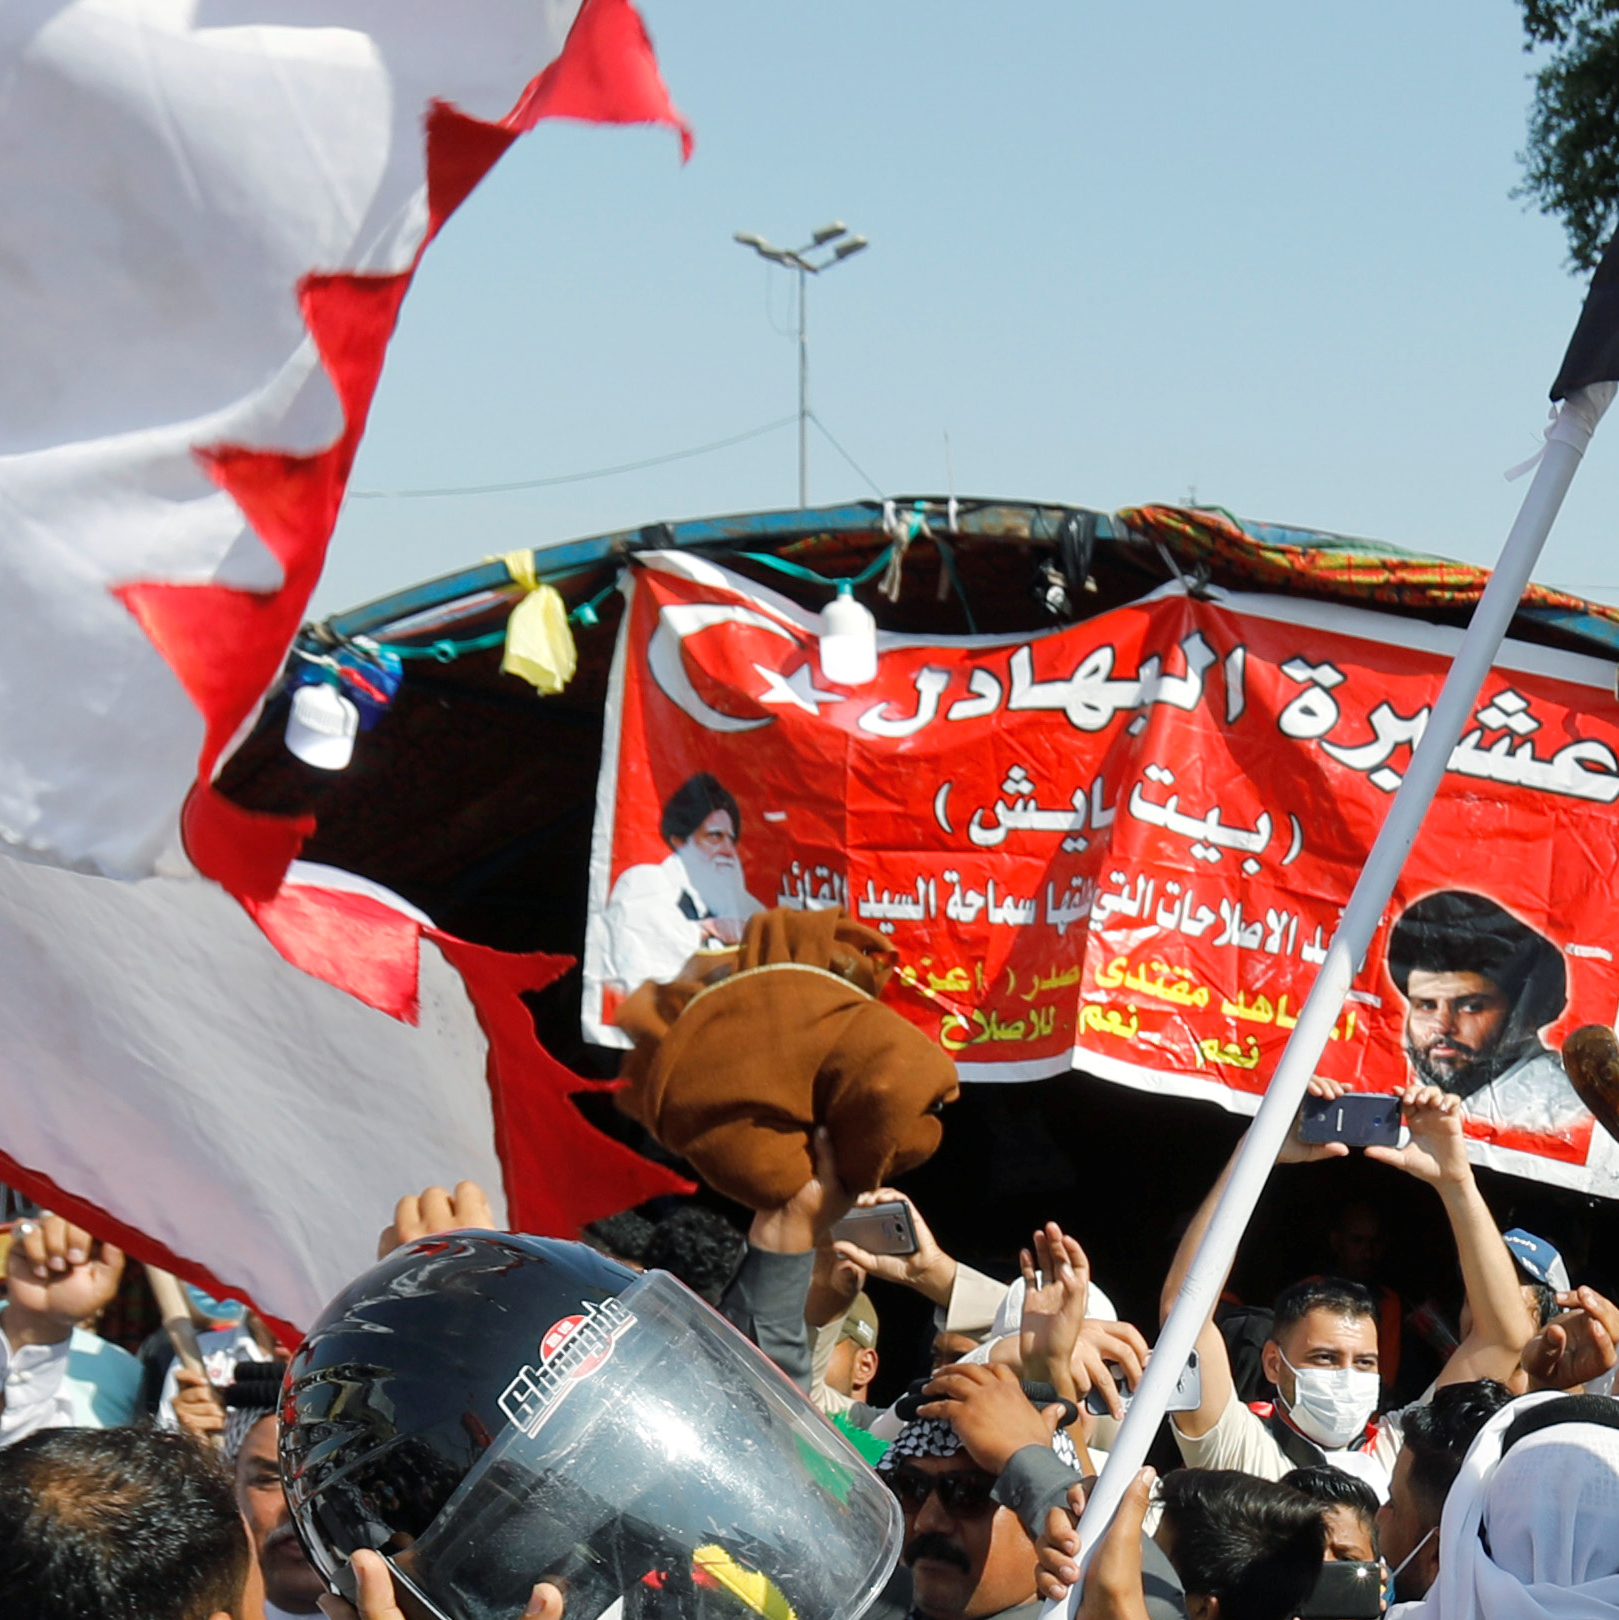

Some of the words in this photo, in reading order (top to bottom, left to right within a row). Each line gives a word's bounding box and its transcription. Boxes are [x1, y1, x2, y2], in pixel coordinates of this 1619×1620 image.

[857, 874, 938, 936] السيد
[945, 869, 1037, 928] سماحة
[1088, 869, 1156, 933] التي
[1093, 955, 1211, 1010] مقتدى
[1078, 1002, 1140, 1041] نعم
